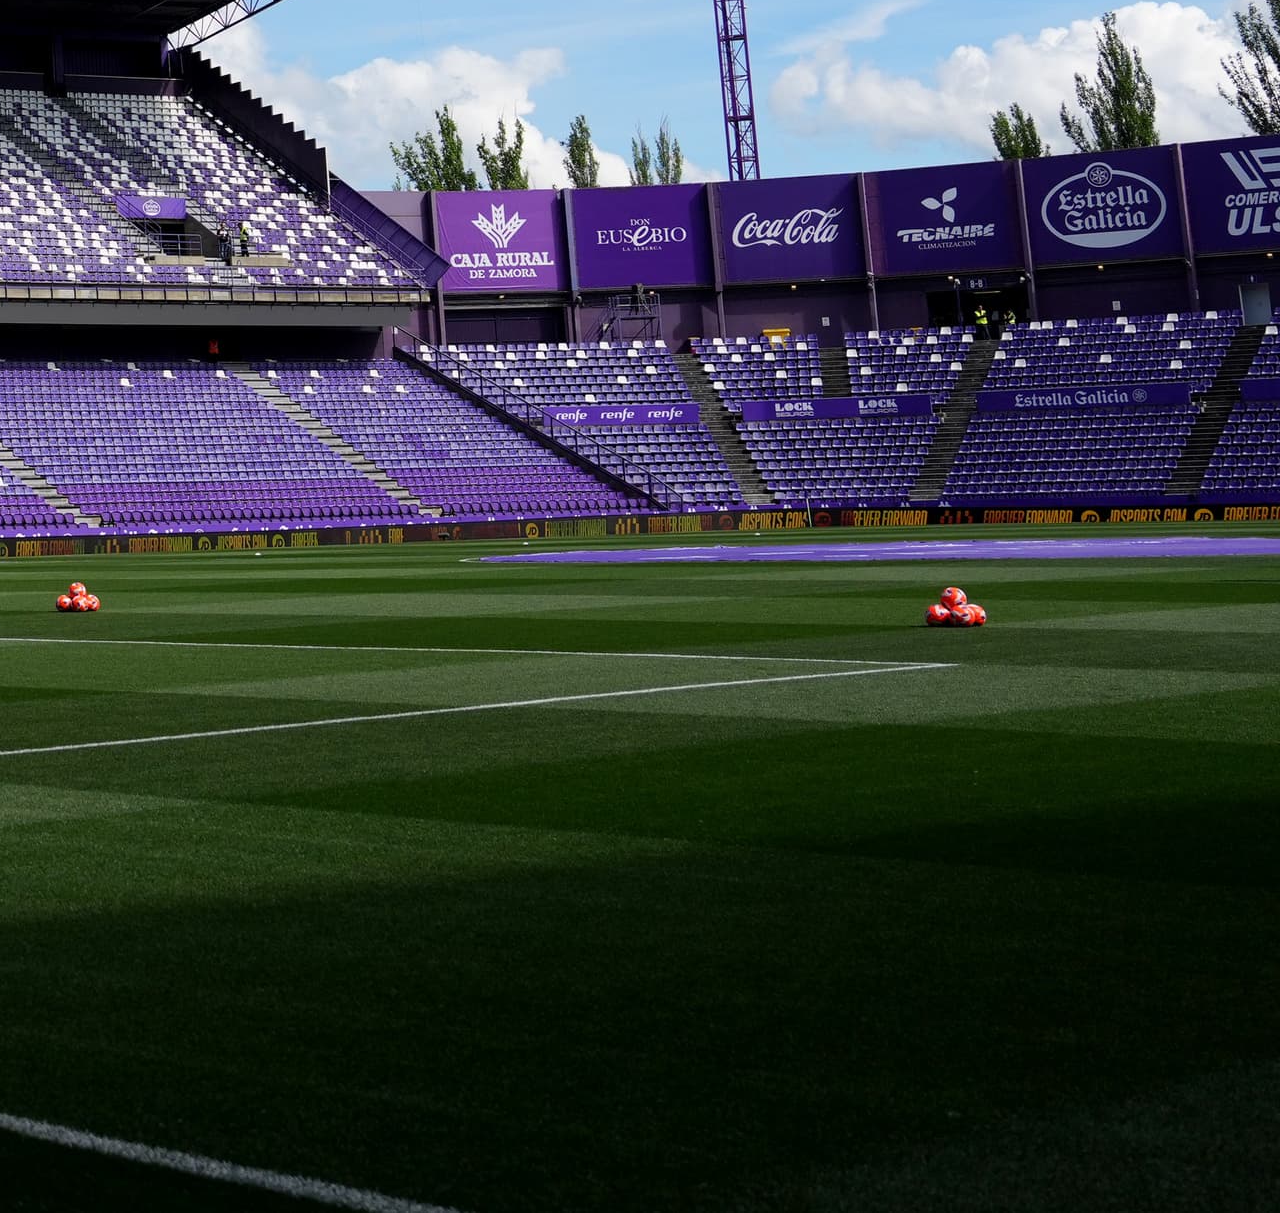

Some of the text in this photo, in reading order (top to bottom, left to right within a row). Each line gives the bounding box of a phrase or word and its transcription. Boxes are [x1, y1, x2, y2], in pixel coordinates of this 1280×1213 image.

[1058, 185, 1149, 211] Estrella
[1225, 191, 1280, 208] COMER
[630, 218, 651, 227] DON
[731, 207, 845, 248] Coca-Cola
[1064, 206, 1149, 232] Galicia
[896, 223, 995, 243] TECNAIRE
[450, 252, 555, 268] CAJA RURAL
[469, 269, 538, 279] DE ZAMORA
[775, 402, 814, 412] LOCK
[858, 399, 898, 409] LOCK
[1014, 389, 1129, 408] Estrella Galicia
[556, 406, 683, 423] renfe renfe renfe
[881, 509, 929, 526] FORWARD
[983, 509, 1074, 524] FOREVER FORWARD
[1223, 507, 1269, 522] FOREVER
